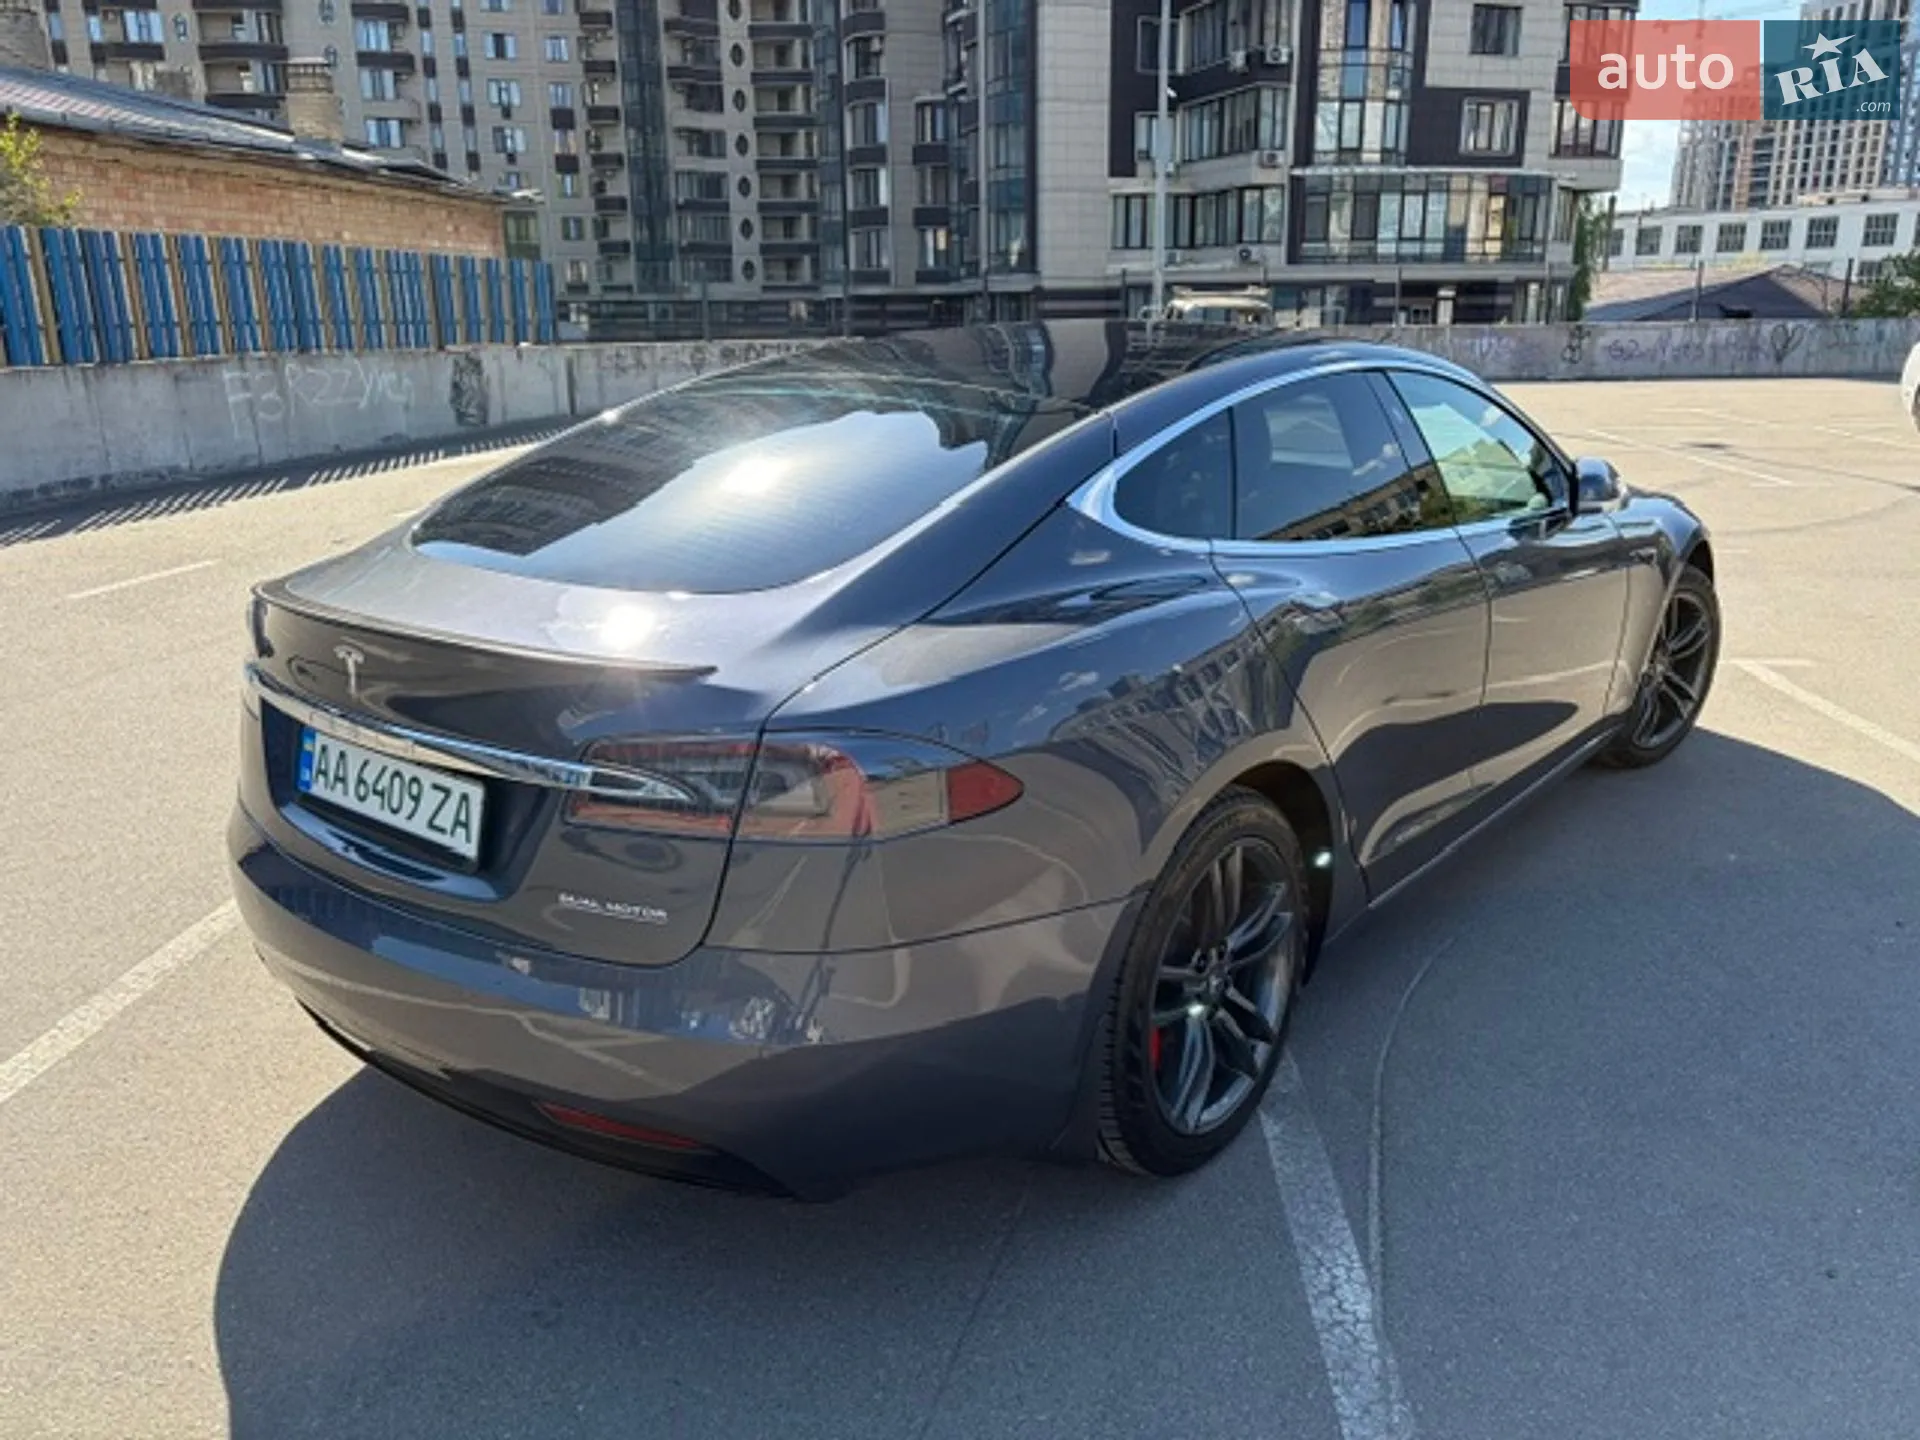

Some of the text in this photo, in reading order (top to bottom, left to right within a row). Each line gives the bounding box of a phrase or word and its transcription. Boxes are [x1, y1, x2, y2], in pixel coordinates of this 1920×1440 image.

[314, 743, 473, 845] AA 6409 ZA
